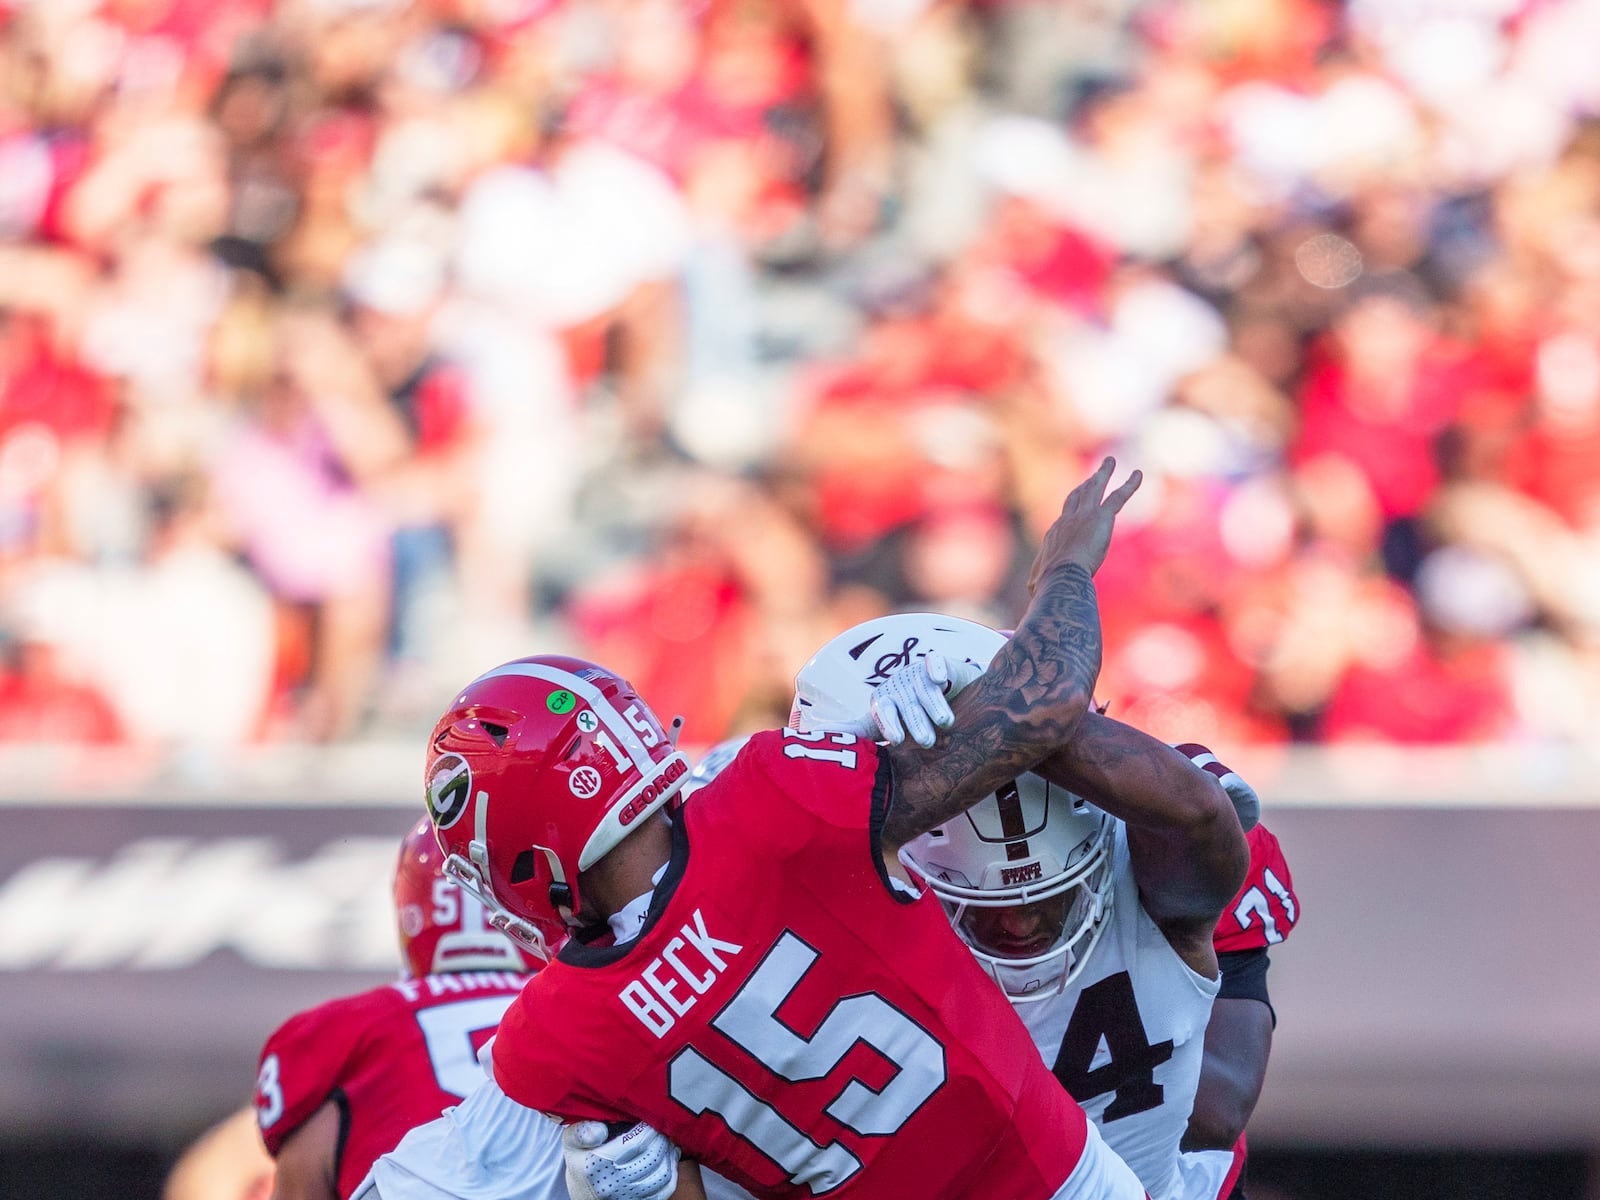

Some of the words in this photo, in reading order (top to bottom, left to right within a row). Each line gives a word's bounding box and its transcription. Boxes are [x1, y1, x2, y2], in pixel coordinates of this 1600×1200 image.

[551, 692, 569, 710] C2P
[572, 769, 598, 795] SEC
[782, 727, 857, 770] 15
[618, 758, 688, 826] GEORGI
[1234, 866, 1297, 946] 71
[618, 908, 743, 1039] BECK
[667, 928, 948, 1197] 15
[1051, 970, 1174, 1122] 4
